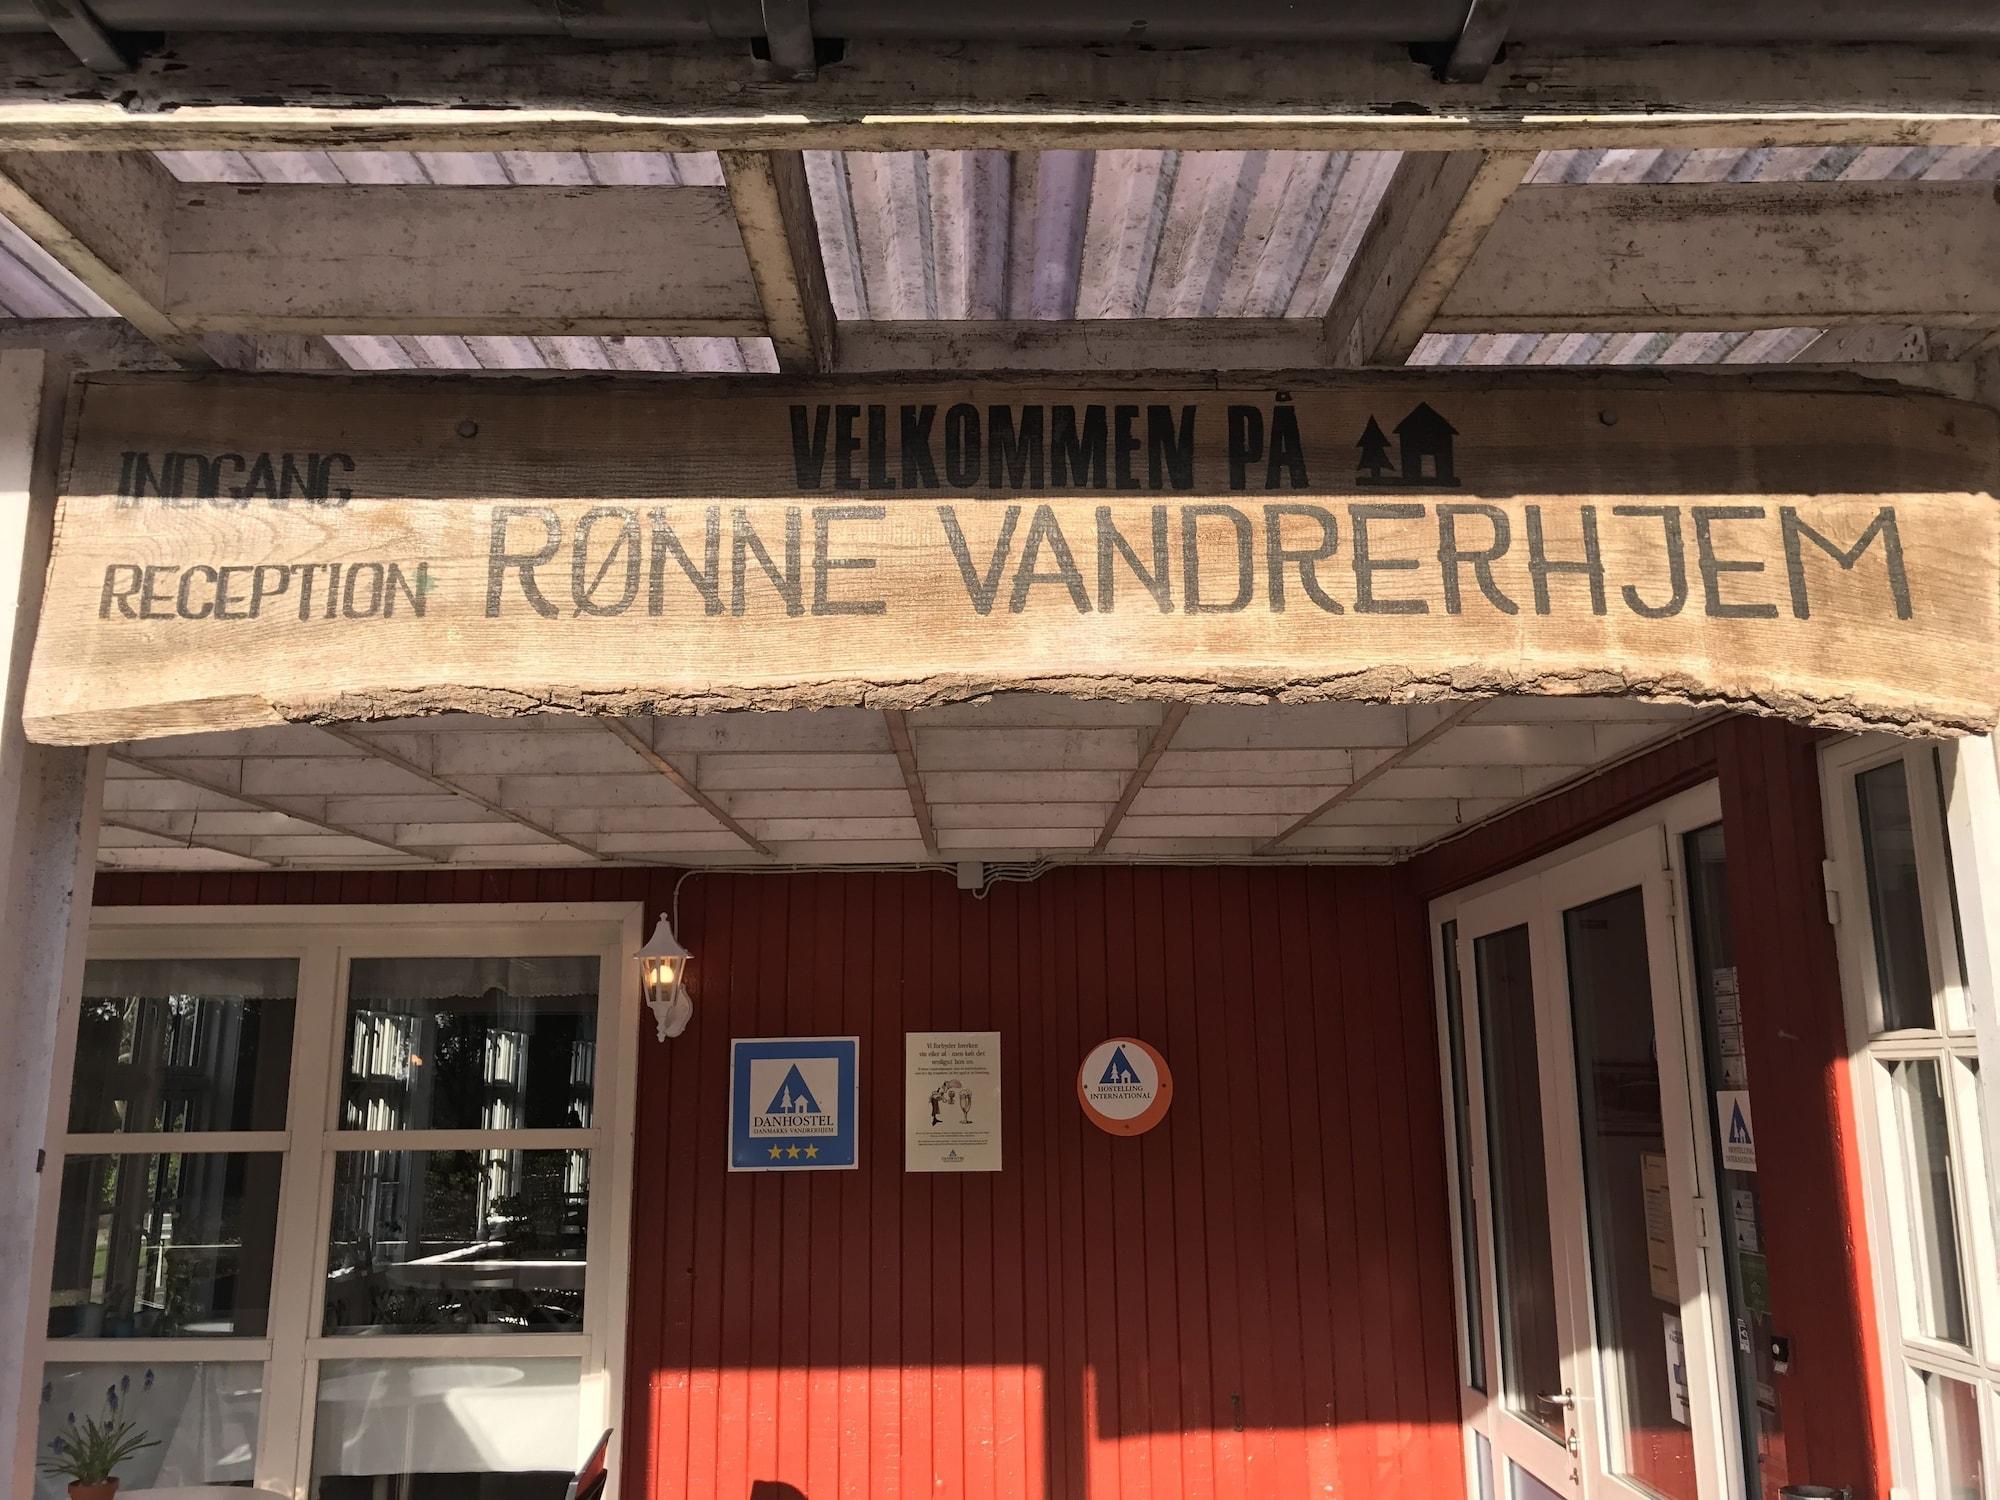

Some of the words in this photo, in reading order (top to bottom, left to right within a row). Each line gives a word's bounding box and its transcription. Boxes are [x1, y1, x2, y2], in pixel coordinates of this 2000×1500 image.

[789, 402, 1197, 490] VELKOMMEN
[1227, 390, 1309, 490] PÅ
[116, 451, 355, 510] INDGANG
[99, 560, 428, 620] RECEPTION
[485, 505, 887, 618] RØNNE
[937, 503, 1913, 620] VANDRERHJEM
[754, 1116, 834, 1127] DANHOSTEL
[1090, 1092, 1152, 1100] INTERNATIONAL
